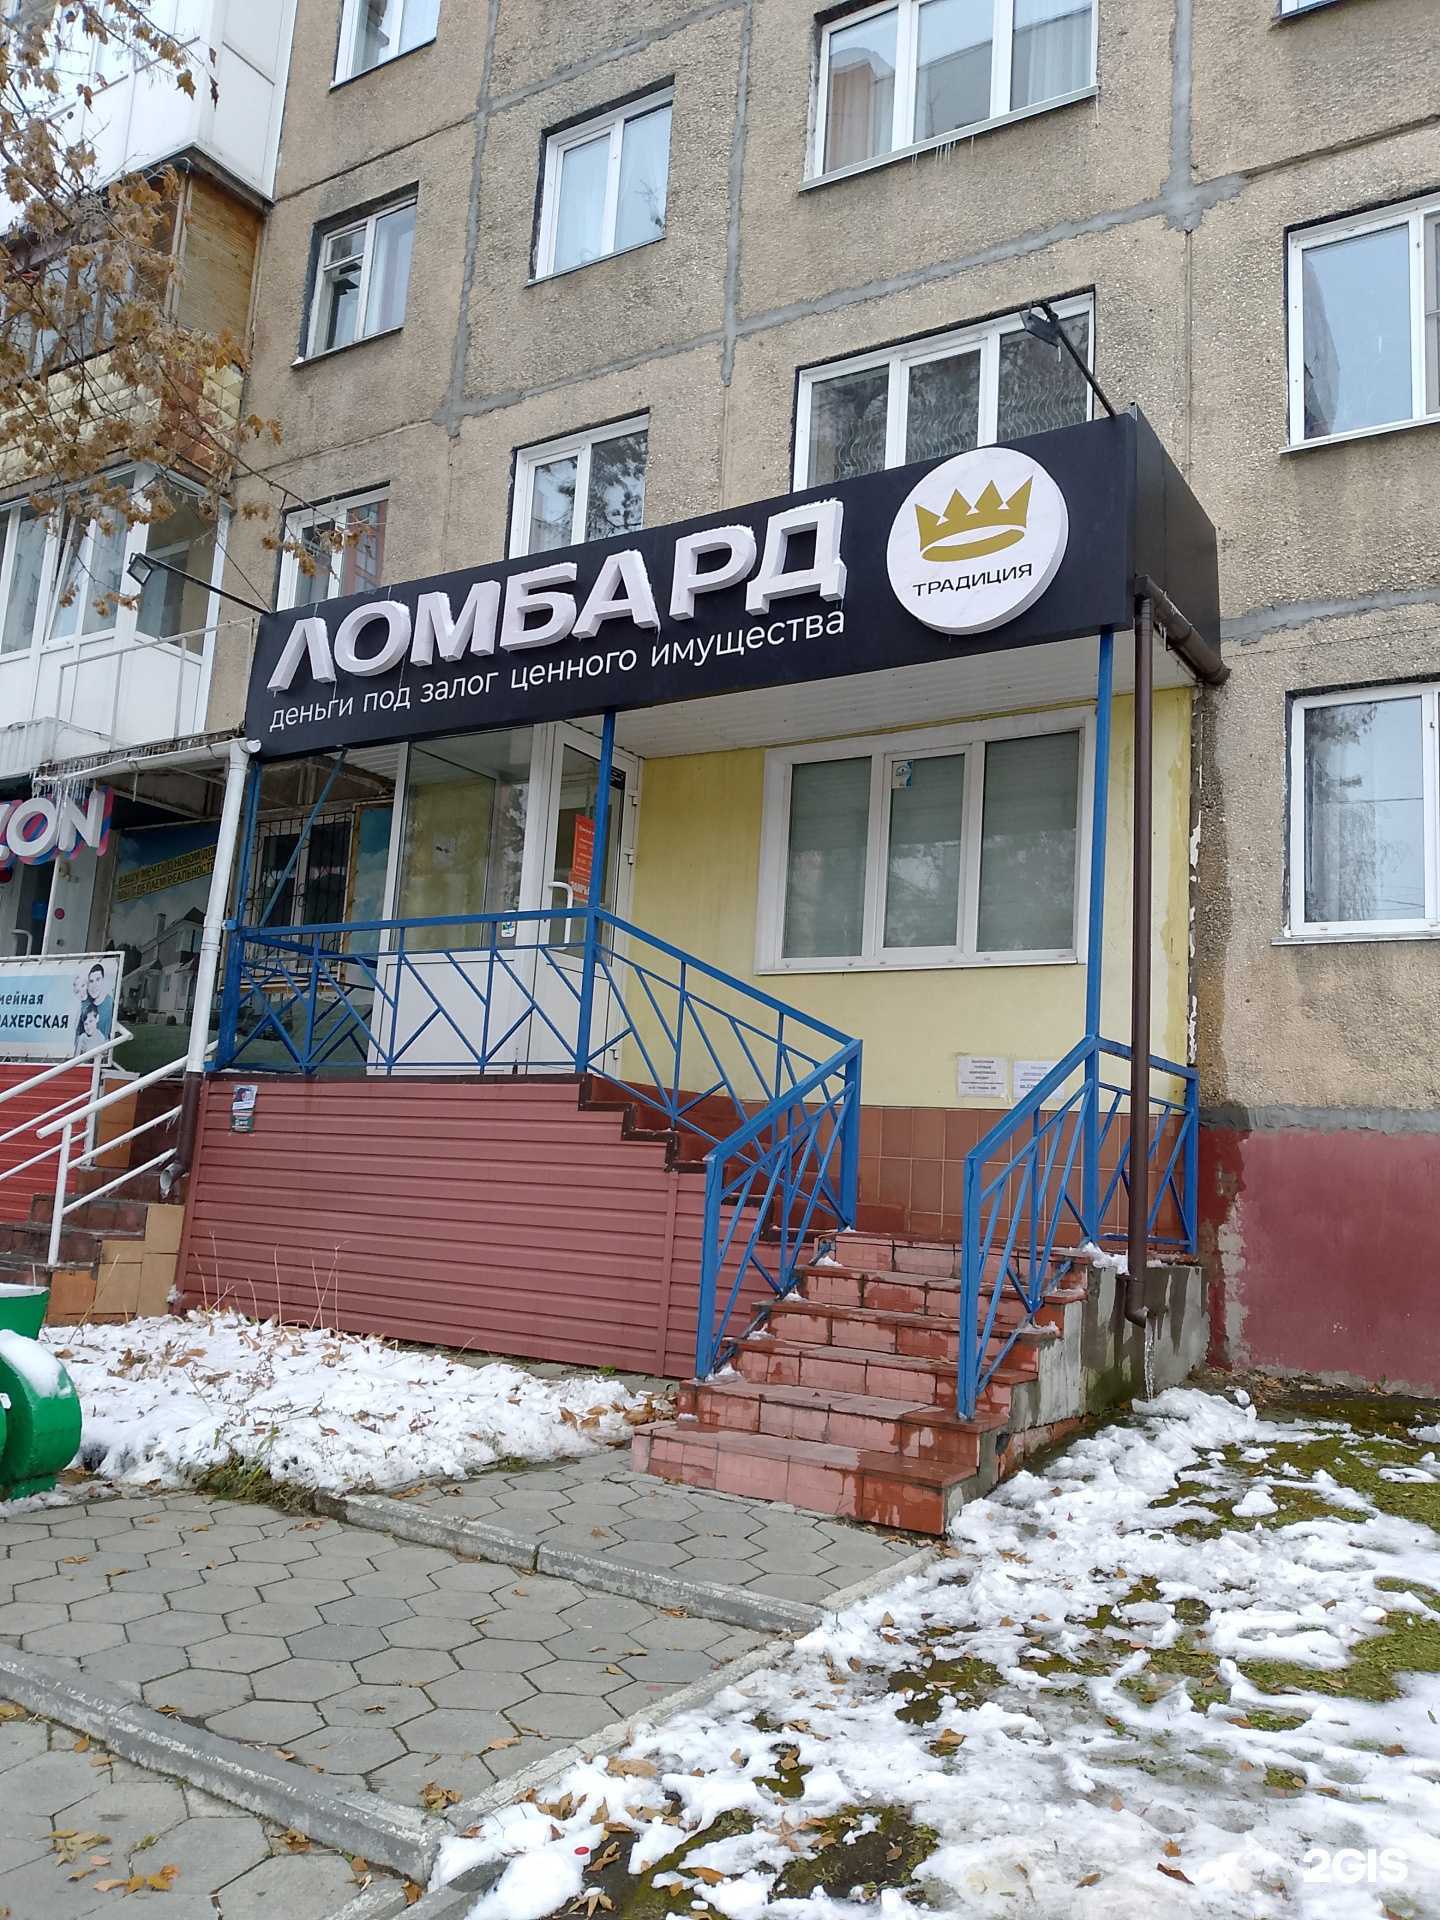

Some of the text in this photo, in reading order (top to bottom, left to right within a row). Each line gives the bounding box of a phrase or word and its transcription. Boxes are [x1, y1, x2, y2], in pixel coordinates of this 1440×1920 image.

[266, 498, 848, 692] ЛОМБАРД
[912, 563, 1033, 597] ТРАДИЦИЯ
[269, 610, 846, 733] деньги под залог ценного имущества
[0, 786, 108, 861] ON
[0, 1014, 69, 1028] АХЕРСКАЯ
